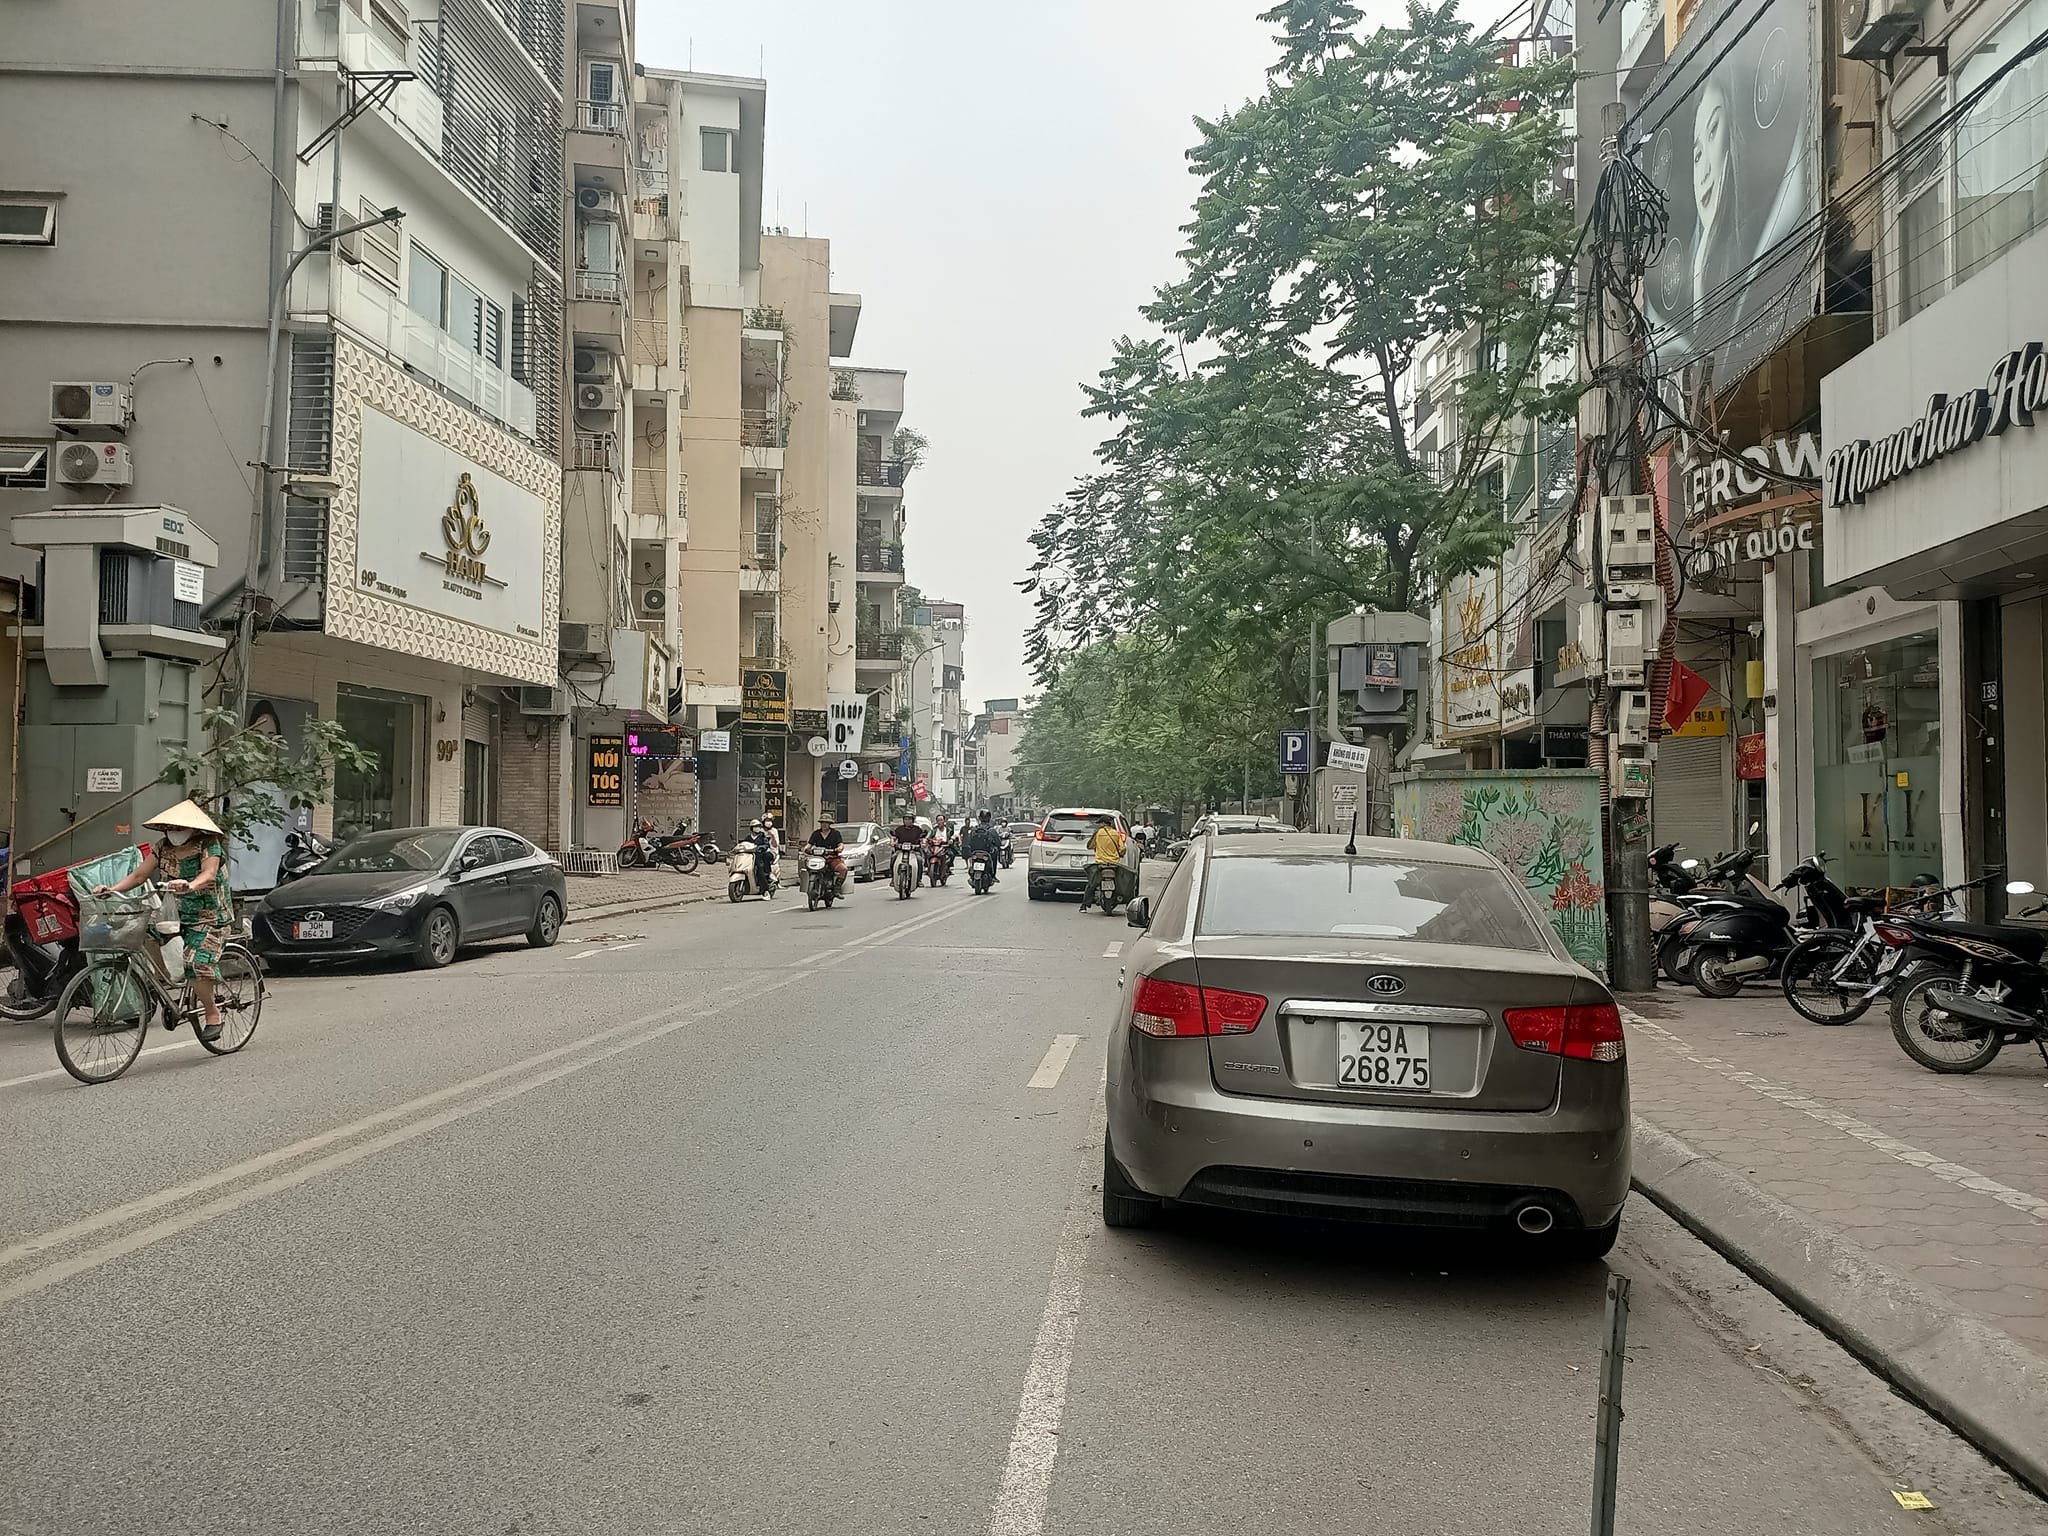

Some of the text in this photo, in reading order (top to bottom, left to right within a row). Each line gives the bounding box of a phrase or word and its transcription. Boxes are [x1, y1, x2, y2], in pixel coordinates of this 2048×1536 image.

[1986, 341, 2048, 437] Ho
[104, 457, 115, 465] LG
[163, 517, 185, 535] EDI
[448, 551, 487, 582] HAMI
[1983, 684, 1996, 699] 138
[831, 700, 863, 719] TRẢ GÓP
[593, 747, 619, 768] NỐI
[1287, 736, 1302, 761] P
[591, 771, 620, 790] TÓC
[1373, 979, 1398, 990] KIA
[1360, 1024, 1408, 1054] 29A
[1341, 1055, 1428, 1086] 268.75
